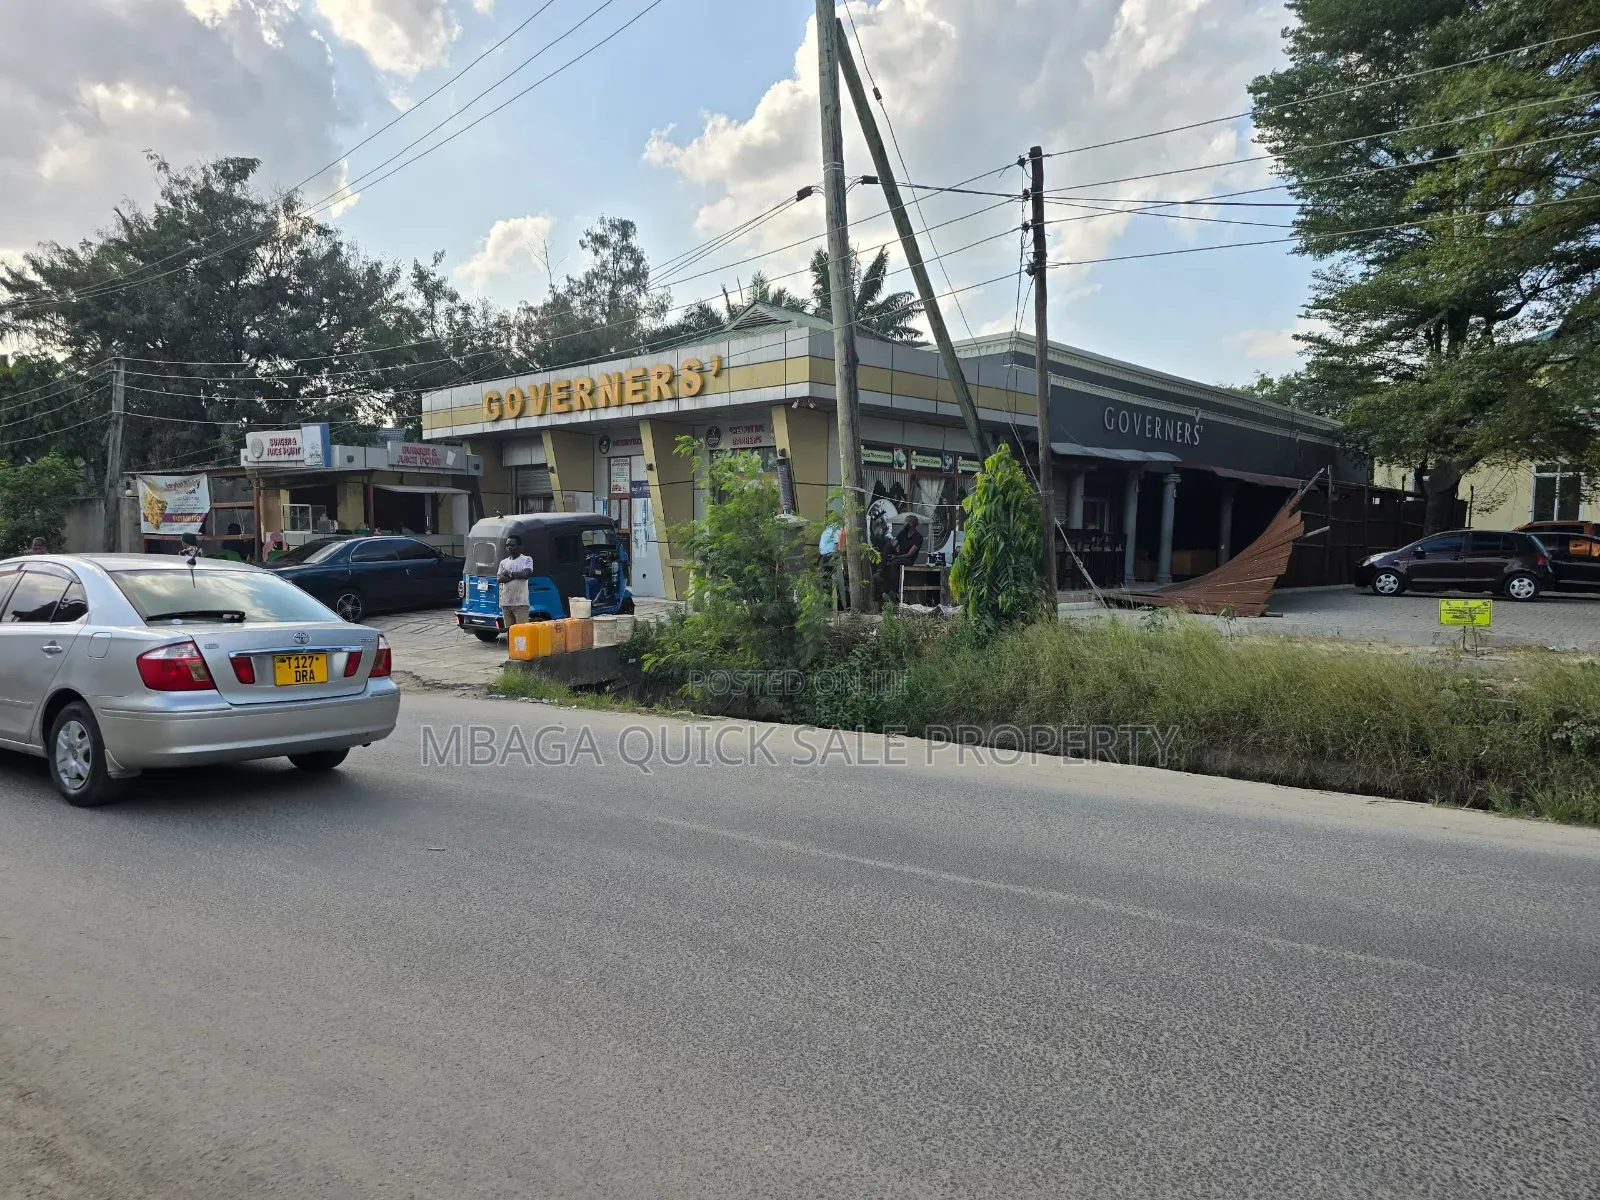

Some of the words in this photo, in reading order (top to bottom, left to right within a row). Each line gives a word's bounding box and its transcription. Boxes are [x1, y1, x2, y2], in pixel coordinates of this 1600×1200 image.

[269, 437, 291, 446] BURGER
[267, 447, 282, 456] JUICE
[283, 447, 301, 456] POINT
[402, 446, 430, 455] BURGER
[397, 455, 417, 464] JUICE
[419, 457, 442, 466] POINT
[294, 669, 316, 683] DRA
